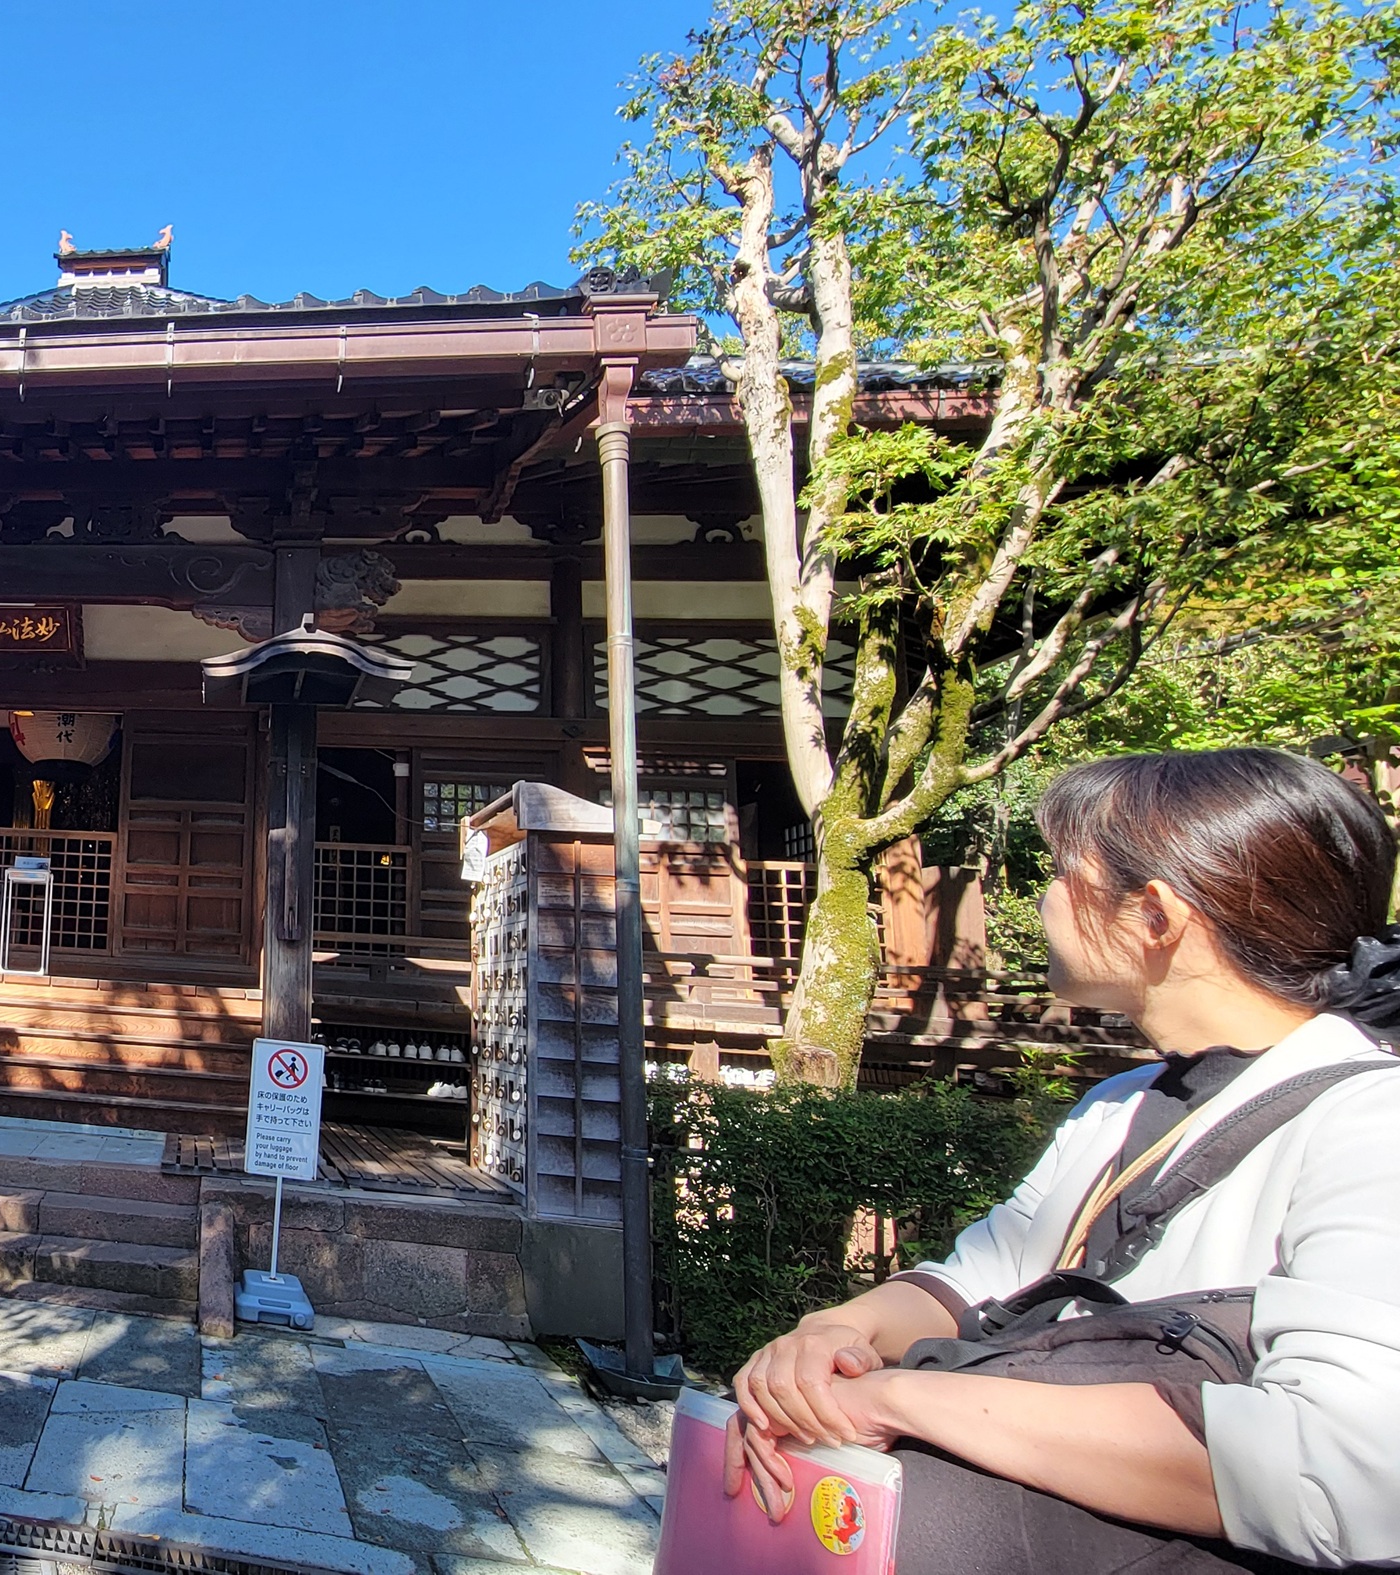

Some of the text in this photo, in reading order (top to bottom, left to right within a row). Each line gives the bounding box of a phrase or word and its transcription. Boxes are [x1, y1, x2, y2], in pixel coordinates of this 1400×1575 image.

[257, 1091, 308, 1103] 床の保護のため
[257, 1103, 310, 1116] キャリーバッグは
[256, 1114, 312, 1128] 手で持って下さい
[256, 1132, 291, 1144] Please carry
[270, 1144, 293, 1153] luggage
[255, 1151, 262, 1159] by
[263, 1151, 278, 1160] hand
[254, 1161, 276, 1169] damage
[285, 1163, 299, 1171] floor
